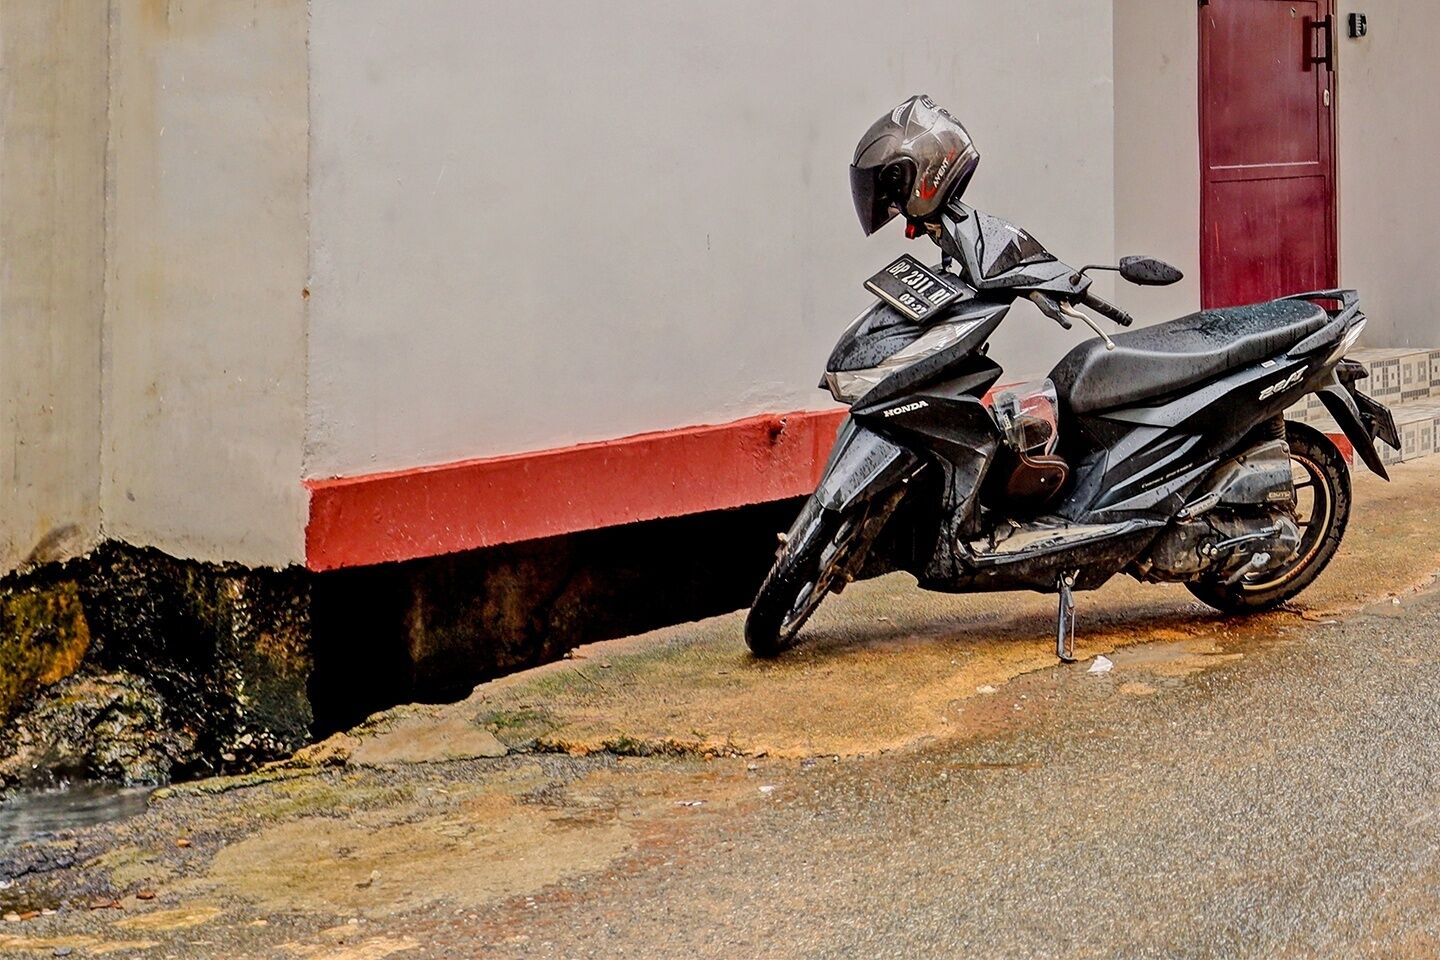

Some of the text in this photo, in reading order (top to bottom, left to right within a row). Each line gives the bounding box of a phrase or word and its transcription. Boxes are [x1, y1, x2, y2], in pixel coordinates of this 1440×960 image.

[889, 260, 911, 279] BP
[901, 270, 935, 295] 2311
[882, 400, 929, 418] HONDA
